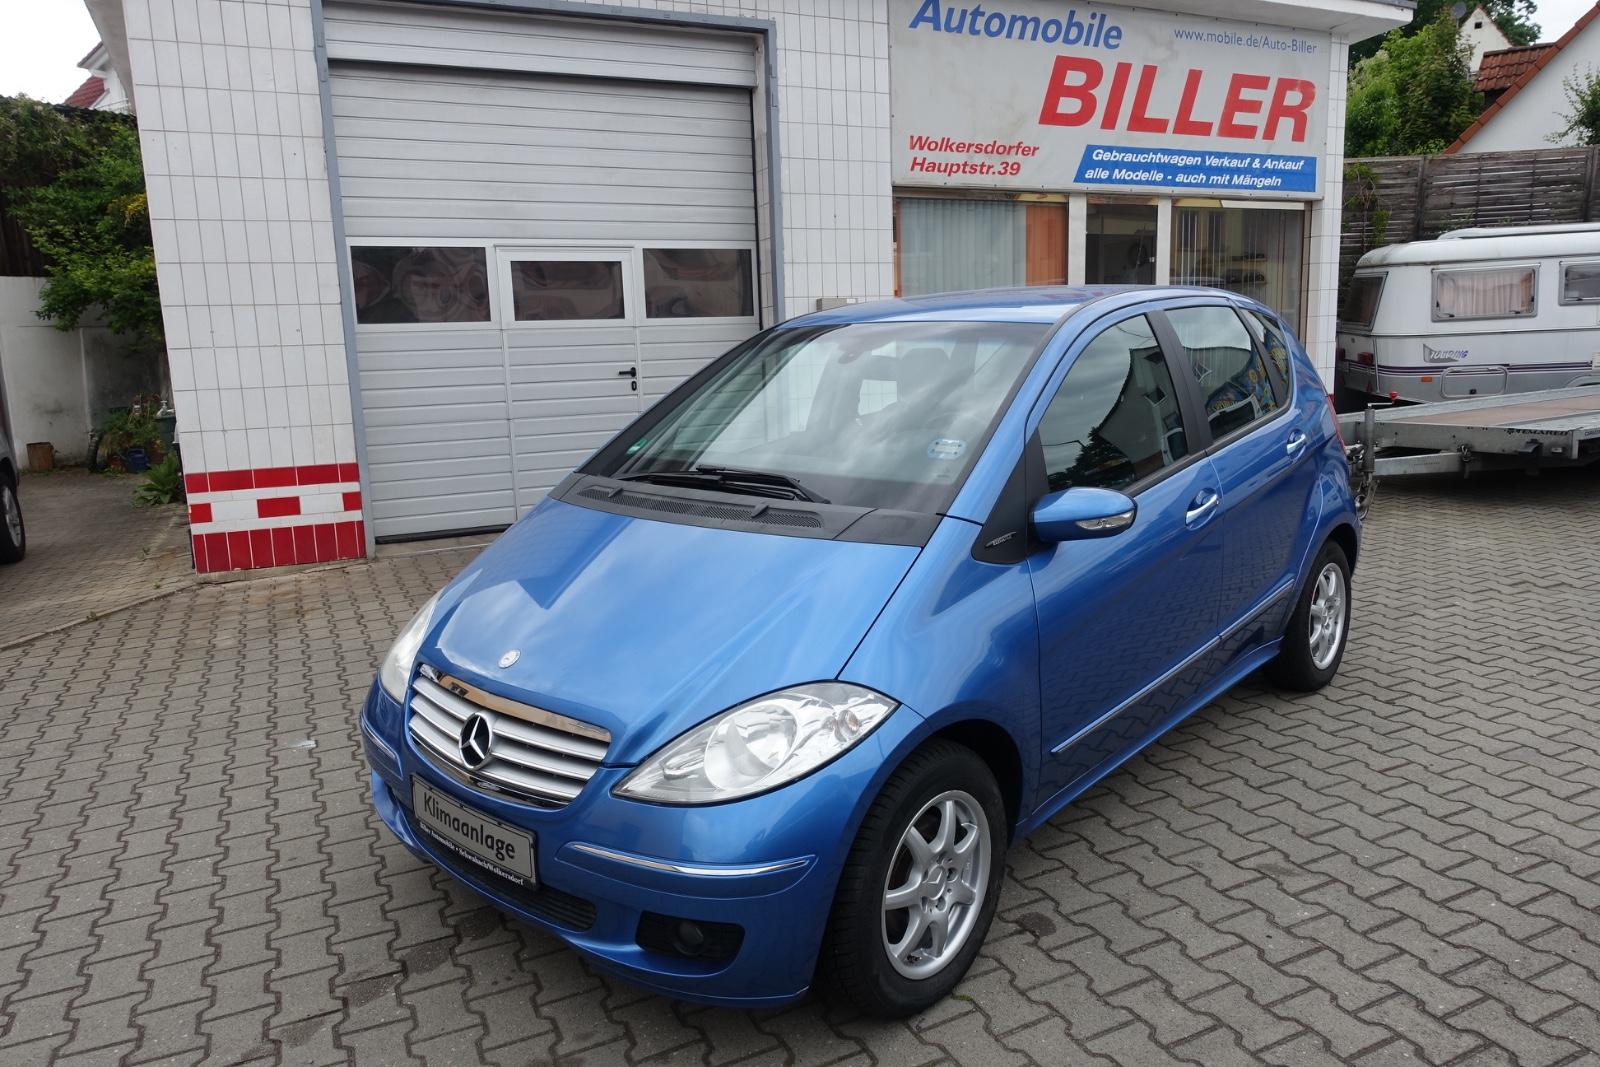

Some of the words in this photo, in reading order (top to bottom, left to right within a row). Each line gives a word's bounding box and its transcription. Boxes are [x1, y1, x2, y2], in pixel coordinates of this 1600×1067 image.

[909, 0, 1122, 49] Automobile
[1174, 29, 1317, 54] www.mobile.de/Auto-Biller
[1038, 55, 1316, 142] BILLER
[909, 135, 1039, 157] Wolkersdorfer
[910, 157, 1021, 176] Hauptstr.39
[1092, 149, 1201, 166] Gebrauchtwagen
[1205, 156, 1251, 168] Verkauf
[1252, 158, 1261, 169] &
[1263, 159, 1305, 171] Ankauf
[1085, 168, 1109, 179] alle
[1112, 169, 1164, 182] Modelle
[1176, 173, 1206, 184] auch
[1209, 174, 1229, 185] mit
[1231, 174, 1282, 188] Mängeln
[424, 792, 515, 861] Klimaanlage
